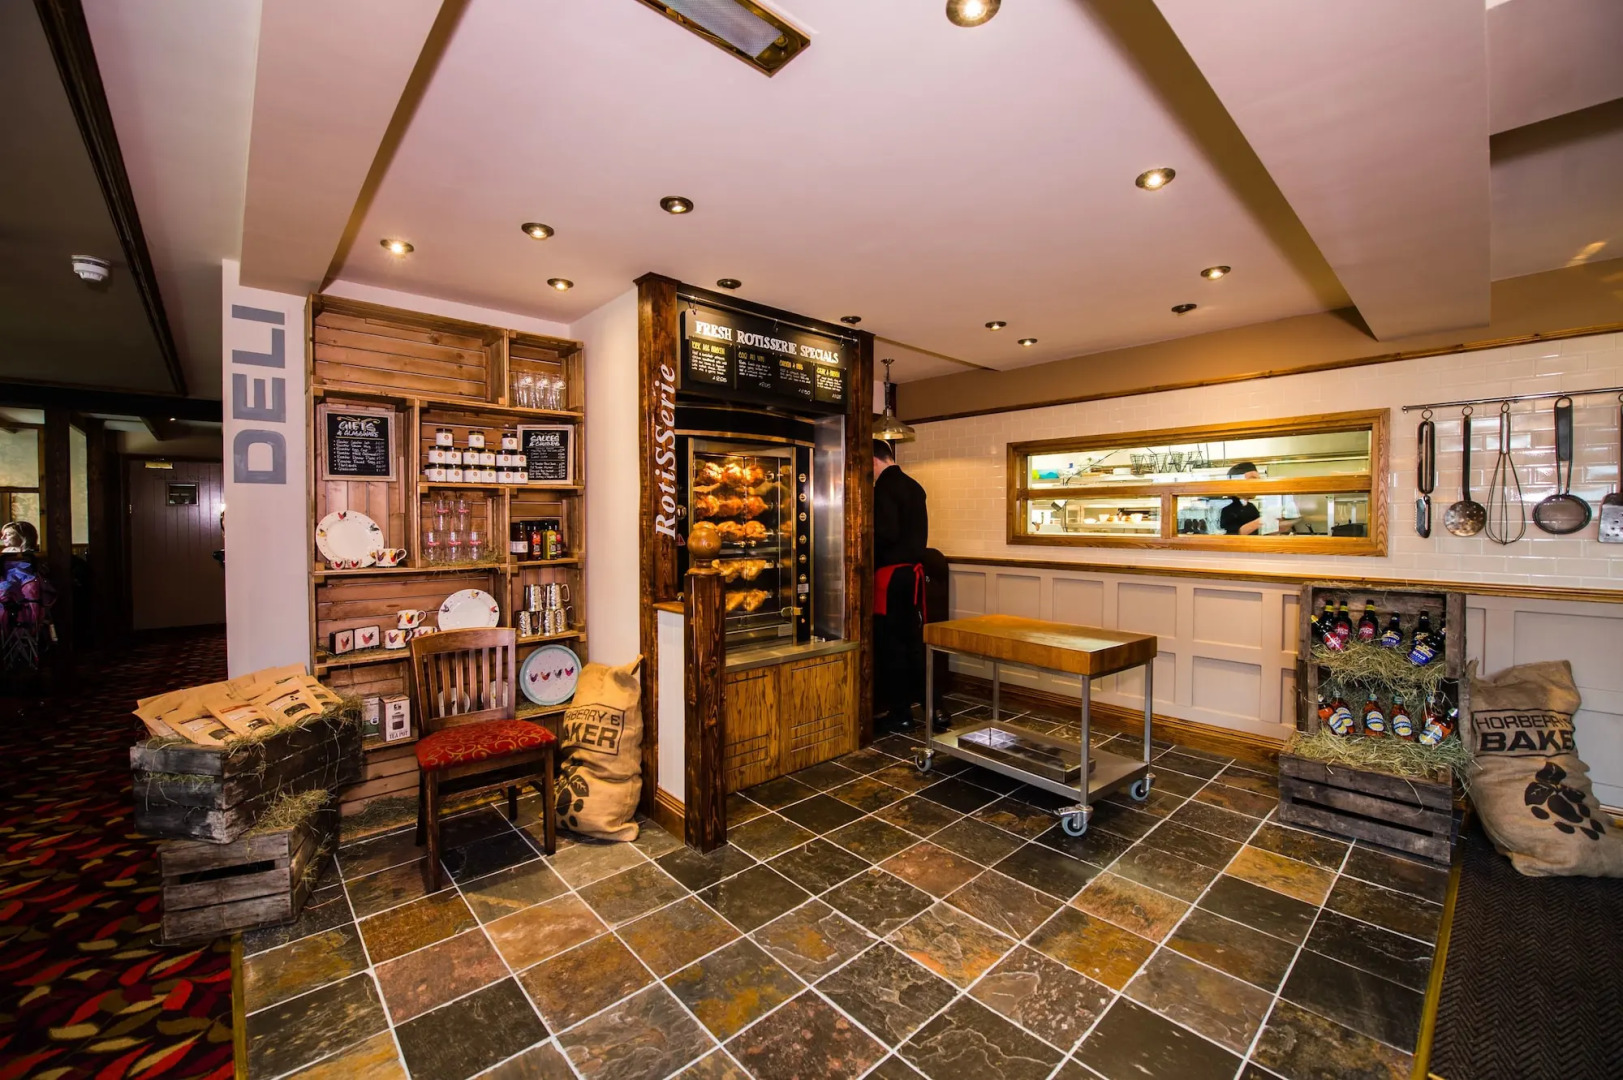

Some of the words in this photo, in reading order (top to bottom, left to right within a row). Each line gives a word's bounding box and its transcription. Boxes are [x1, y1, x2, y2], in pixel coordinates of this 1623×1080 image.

[695, 321, 733, 341] FRESH
[736, 330, 797, 355] ROTISSERIE
[800, 345, 839, 364] SPECIALS
[232, 304, 287, 485] DELI
[338, 420, 376, 431] GIFTS
[564, 708, 608, 724] RBERRY
[389, 732, 399, 740] TEA
[563, 722, 619, 749] AKER
[1480, 730, 1573, 752] BAKE
